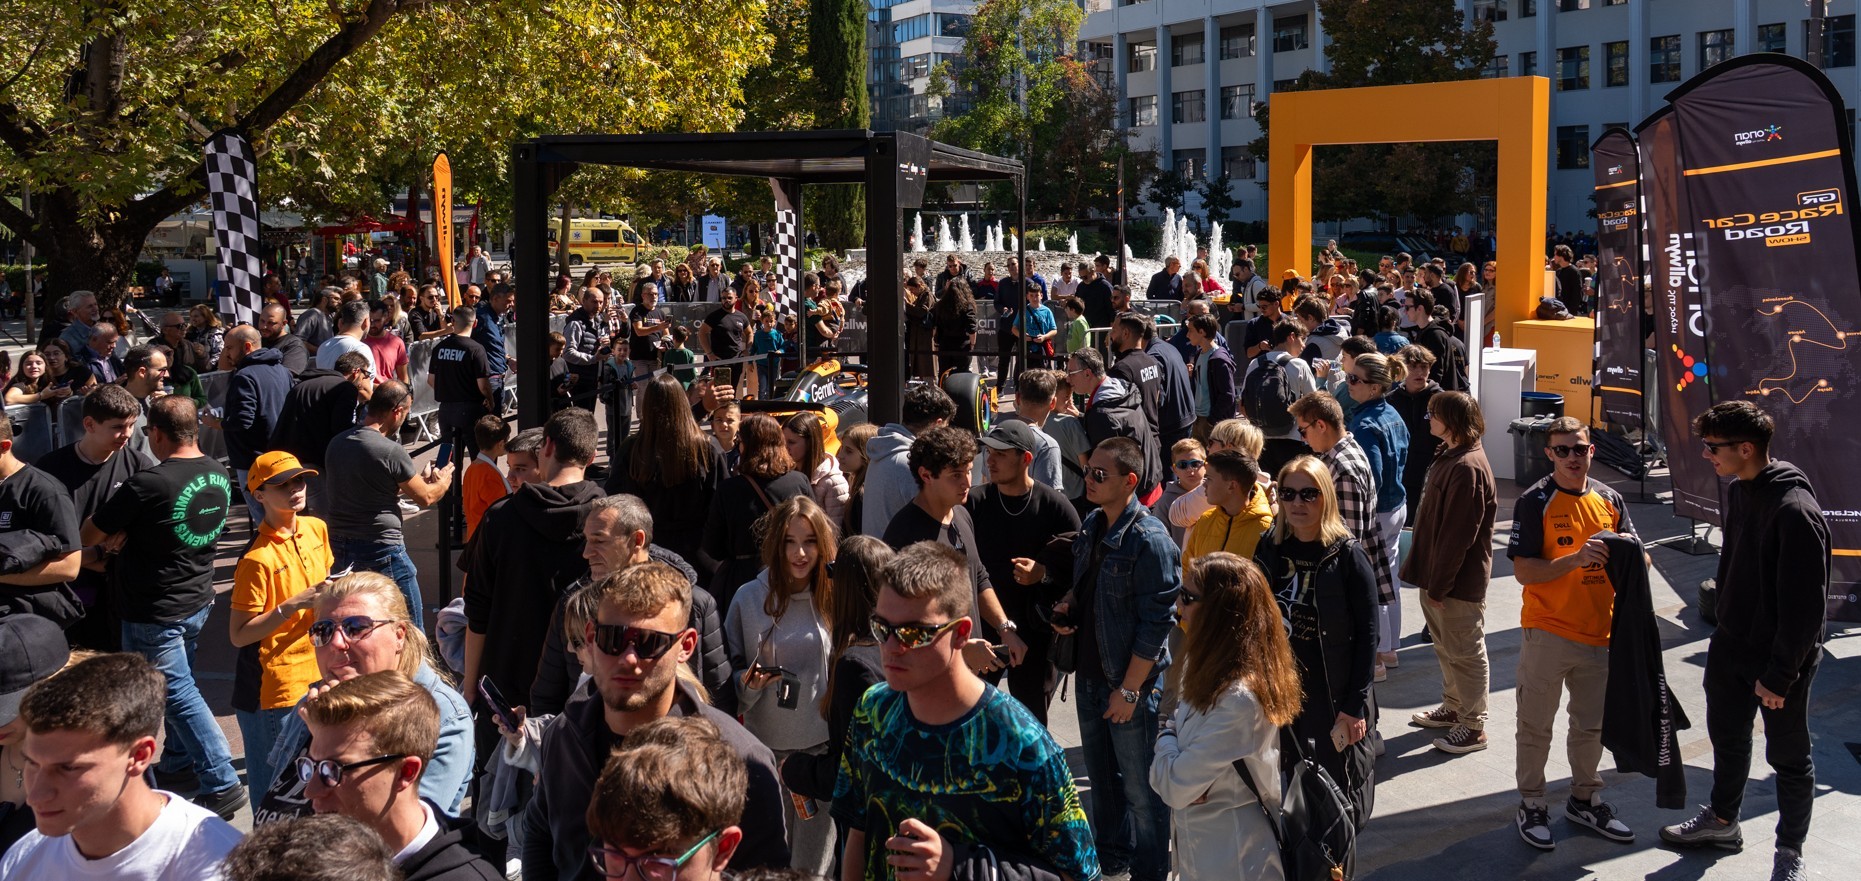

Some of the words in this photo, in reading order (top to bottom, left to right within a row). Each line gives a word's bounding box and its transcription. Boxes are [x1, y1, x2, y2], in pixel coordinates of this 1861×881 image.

[437, 348, 467, 361] CREW
[1140, 364, 1159, 383] CREW
[811, 376, 836, 403] Gemini
[172, 476, 207, 520] SIMPLE
